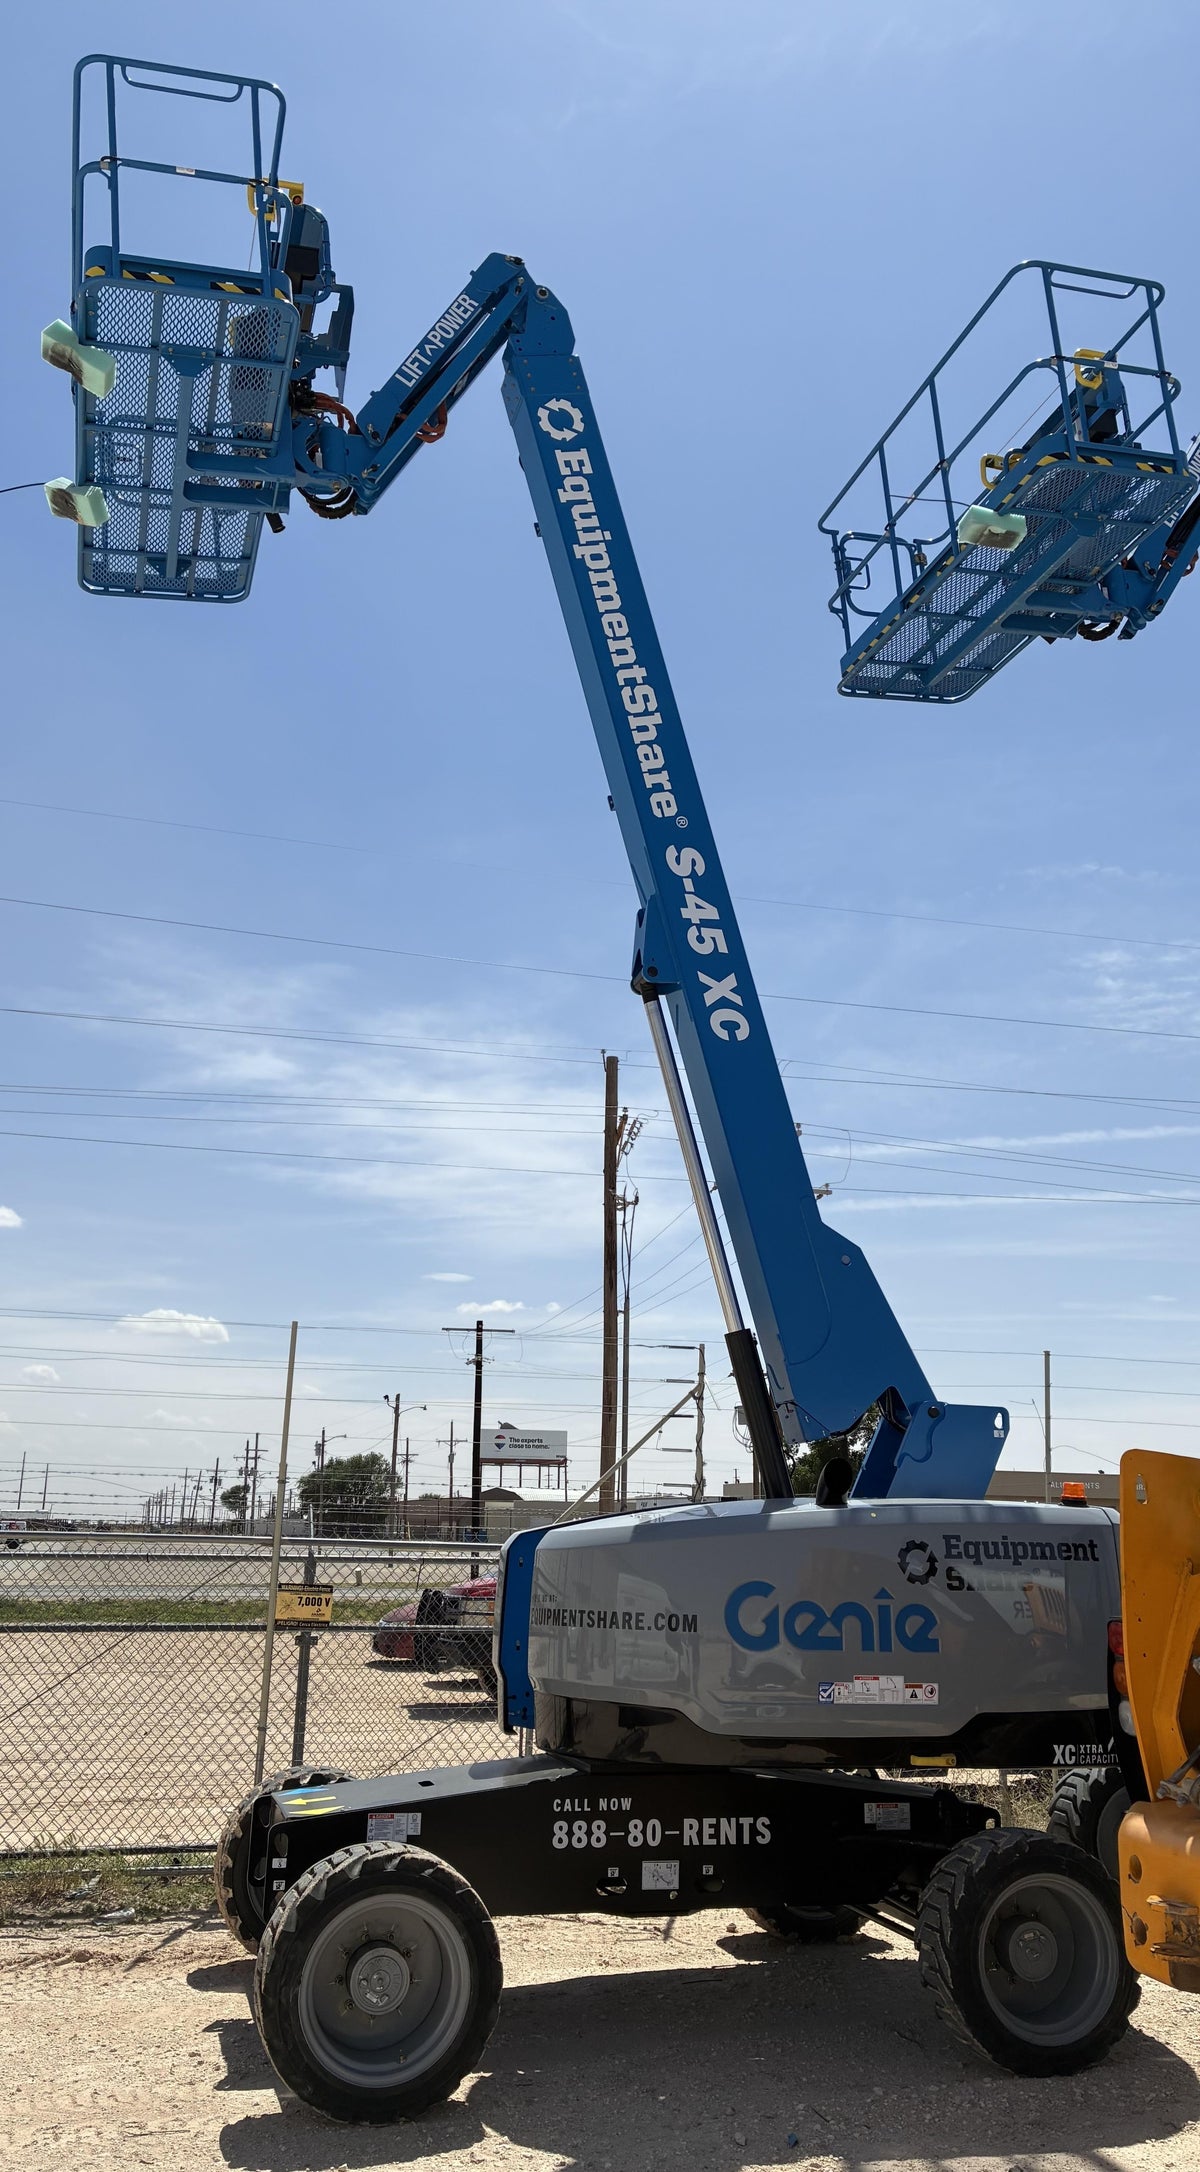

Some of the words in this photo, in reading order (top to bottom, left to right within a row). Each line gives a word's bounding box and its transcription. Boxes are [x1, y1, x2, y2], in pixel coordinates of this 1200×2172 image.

[395, 348, 431, 388] LIFT
[427, 294, 479, 349] POWER
[665, 844, 729, 956] S-45
[697, 970, 750, 1042] XC
[942, 1534, 1100, 1566] Equipment
[297, 1596, 323, 1607] 7,000
[325, 1597, 331, 1607] V
[723, 1580, 941, 1654] Genie
[530, 1607, 699, 1633] EQUIPMENTSHARE.COM
[1053, 1744, 1076, 1765] XC
[1079, 1744, 1104, 1754] XTRA
[553, 1798, 592, 1813] CALL
[599, 1797, 633, 1811] NOW
[552, 1816, 772, 1850] 888-80-RENTS
